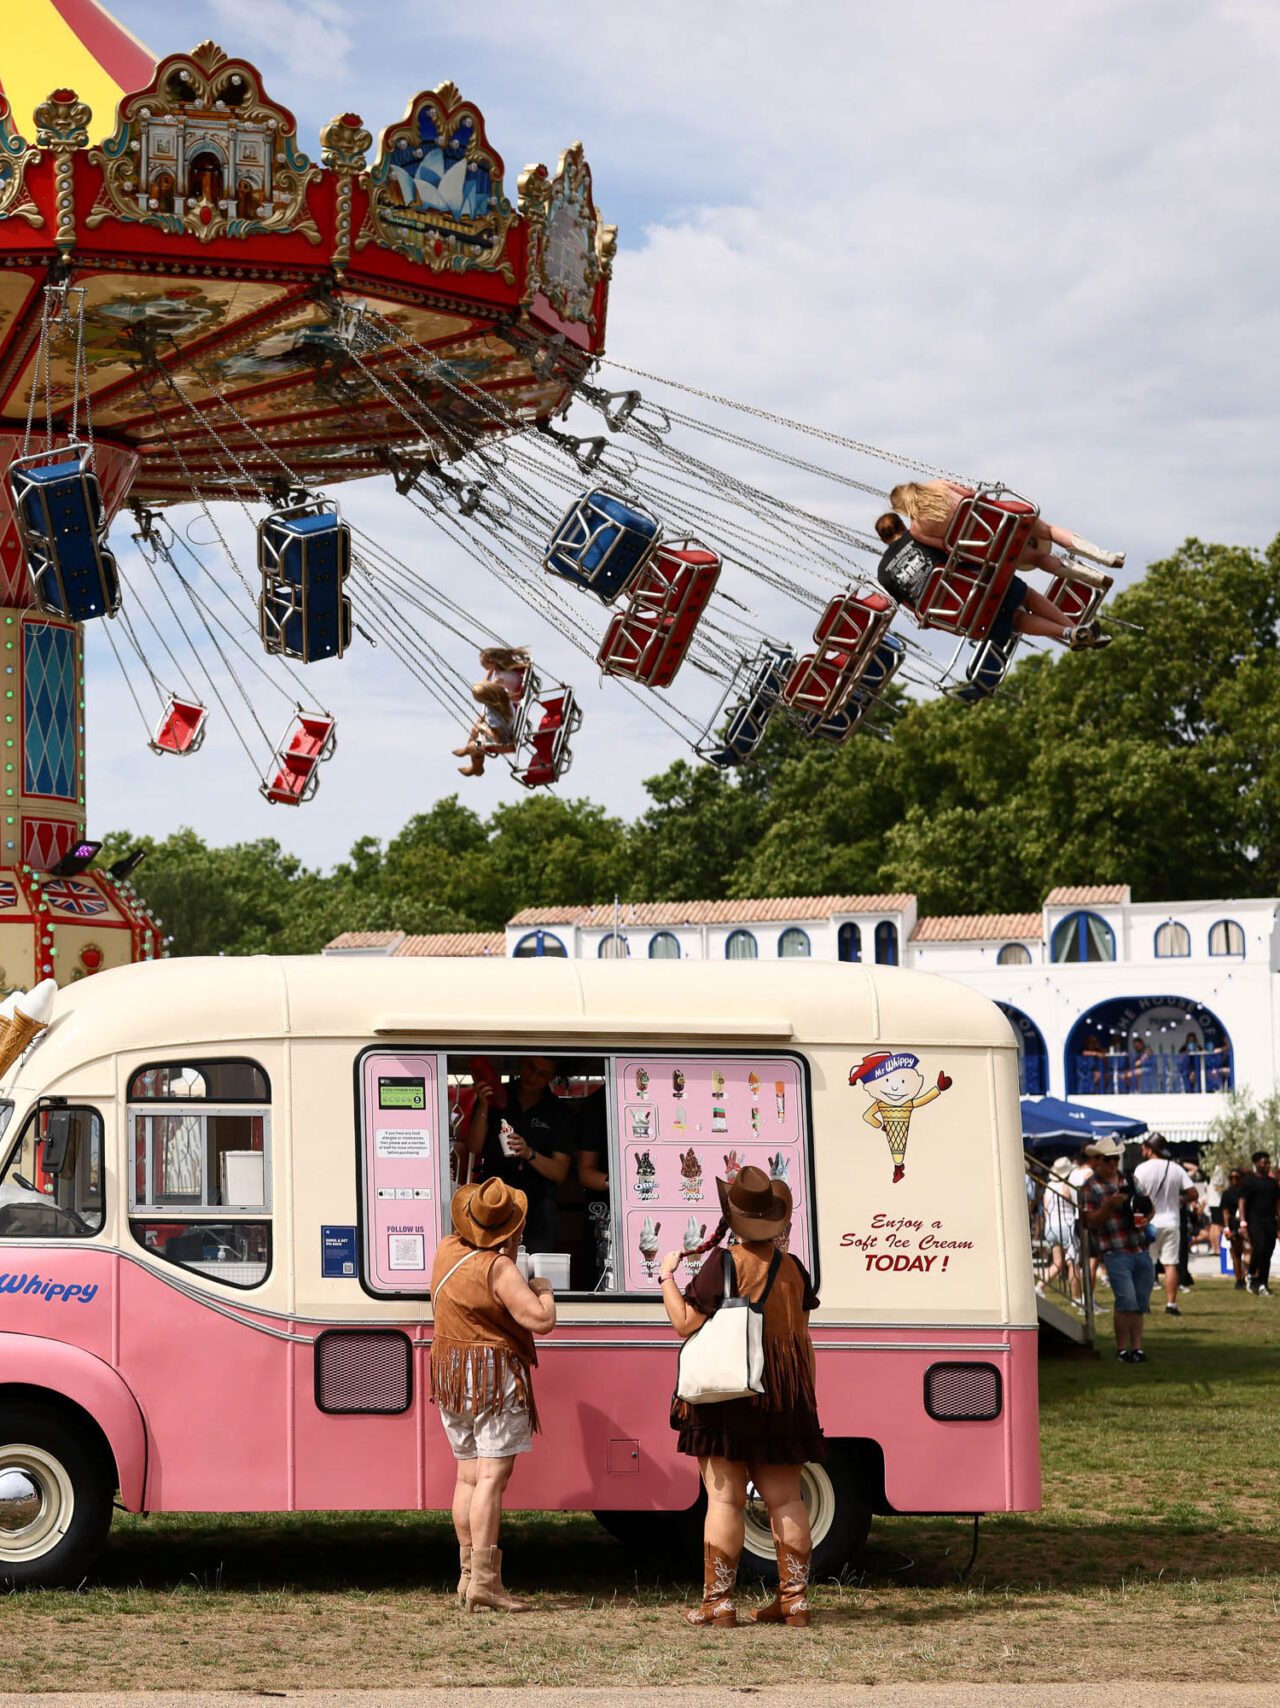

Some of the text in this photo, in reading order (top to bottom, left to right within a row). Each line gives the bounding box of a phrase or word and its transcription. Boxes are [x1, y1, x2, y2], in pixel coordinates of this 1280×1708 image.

[1199, 1014, 1216, 1035] OF
[885, 1056, 915, 1073] Whippy
[871, 1213, 944, 1232] Enjoy a
[839, 1233, 975, 1251] Soft Ice Cream
[865, 1254, 938, 1272] TODAY
